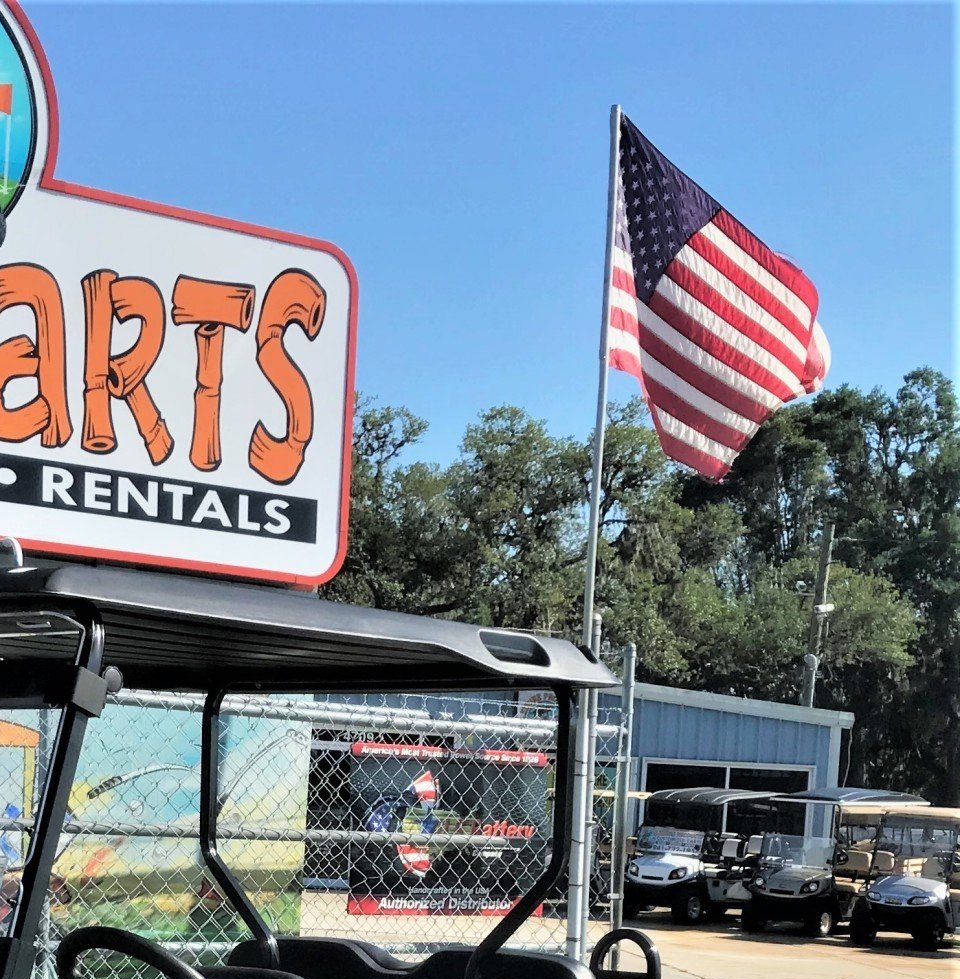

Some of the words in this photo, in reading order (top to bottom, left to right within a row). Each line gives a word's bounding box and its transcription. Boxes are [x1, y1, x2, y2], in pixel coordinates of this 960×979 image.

[41, 465, 292, 535] RENTALS
[361, 745, 400, 756] America's
[401, 748, 421, 757] Most
[422, 749, 449, 758] Trusted
[474, 752, 501, 761] Source
[501, 753, 521, 763] Since
[379, 897, 445, 910] Authorized
[448, 897, 514, 911] Distributor
